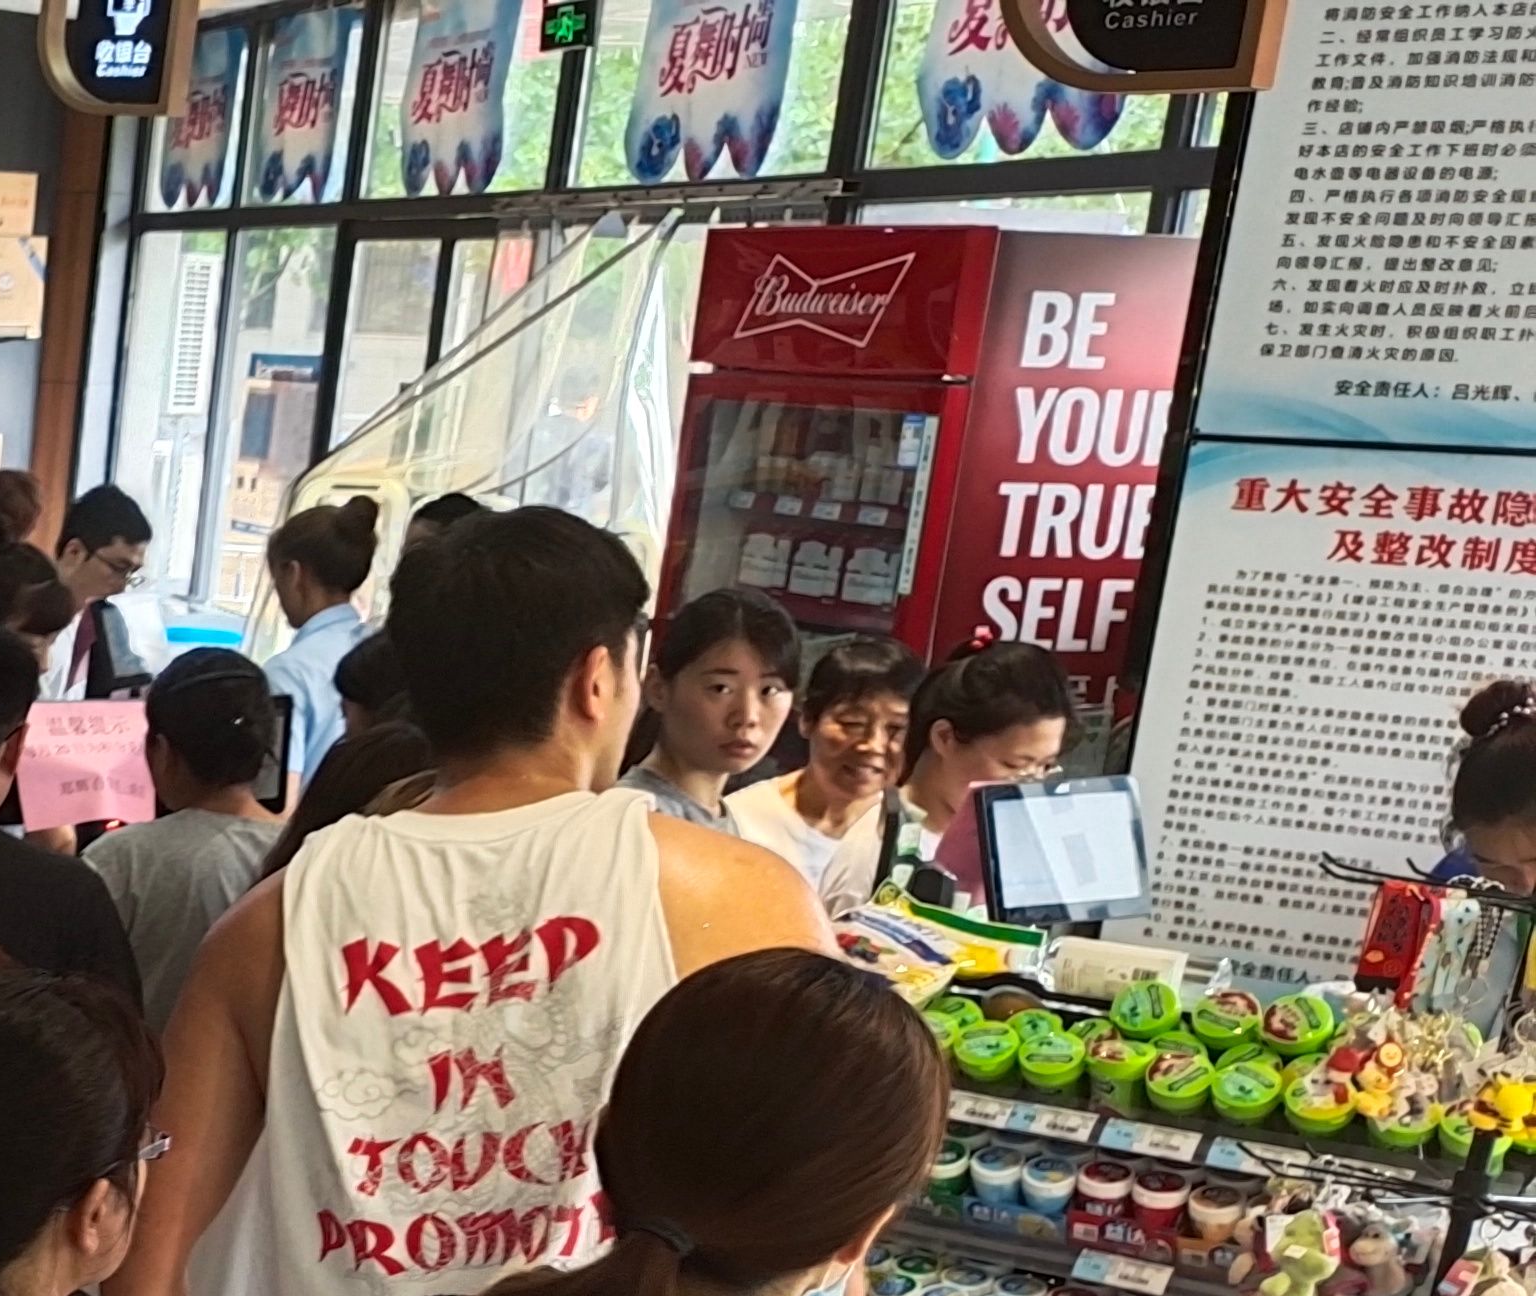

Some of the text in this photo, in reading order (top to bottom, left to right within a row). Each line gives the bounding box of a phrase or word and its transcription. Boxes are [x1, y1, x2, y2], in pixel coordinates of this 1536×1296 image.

[1104, 10, 1199, 30] Cashier
[94, 40, 153, 65] 收银台
[95, 61, 148, 79] Cashier
[754, 273, 889, 317] Budweiser
[1020, 290, 1116, 369] BE
[981, 577, 1135, 653] SELF
[340, 914, 601, 1018] KEEP
[427, 1045, 516, 1115] IN
